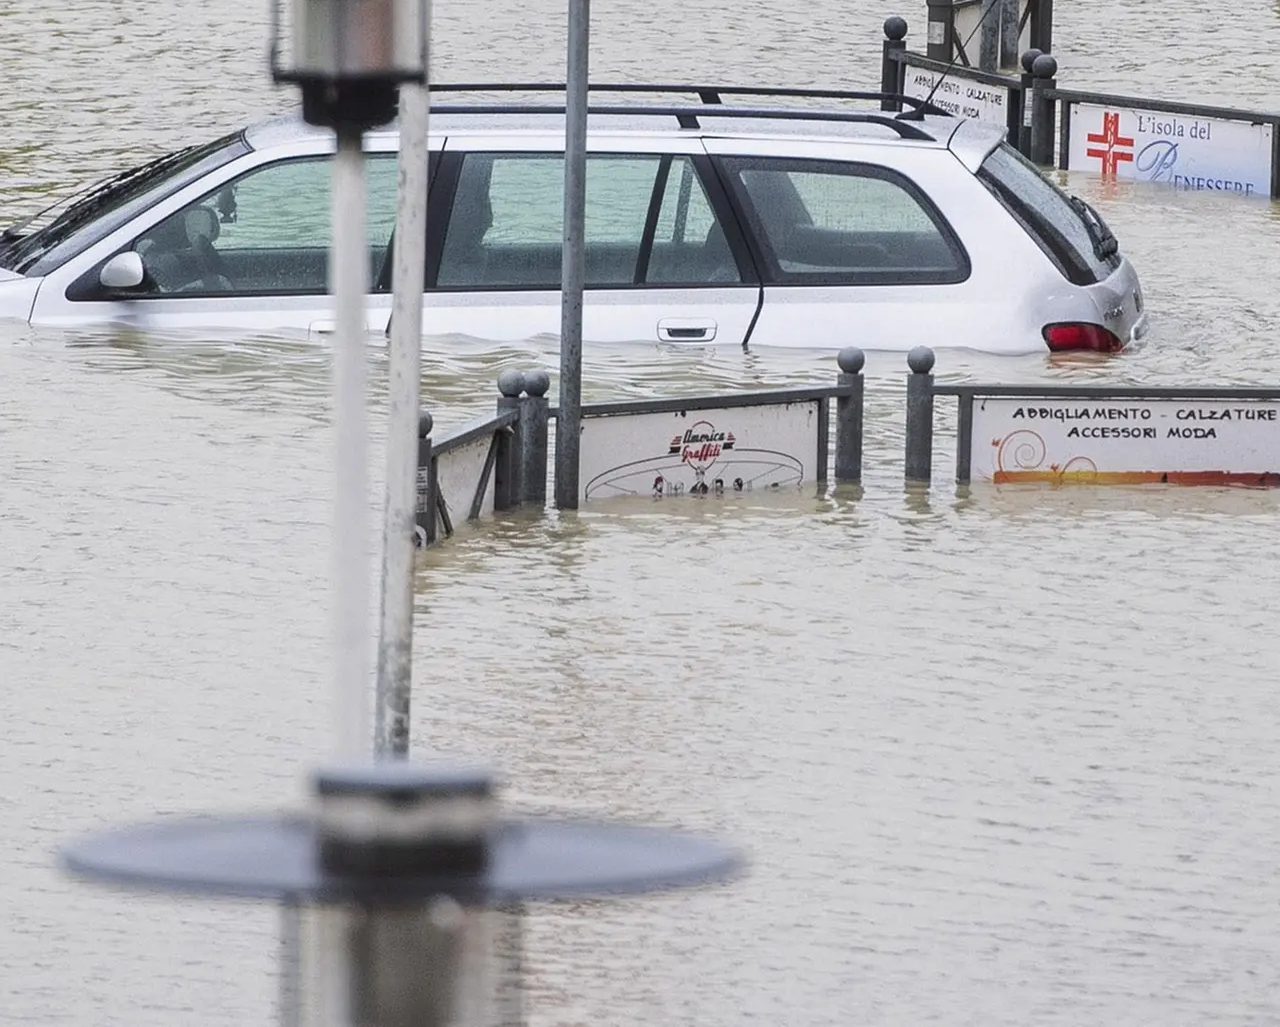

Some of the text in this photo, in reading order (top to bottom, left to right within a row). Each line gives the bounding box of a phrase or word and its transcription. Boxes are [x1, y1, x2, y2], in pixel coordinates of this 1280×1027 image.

[1138, 116, 1211, 140] L'isola del
[1012, 408, 1152, 422] ABBIGLIAMENTO
[1175, 409, 1278, 421] CALZATURE
[683, 429, 724, 443] America
[1067, 427, 1217, 439] ACCESSORI MODA
[681, 443, 721, 462] Graffiti
